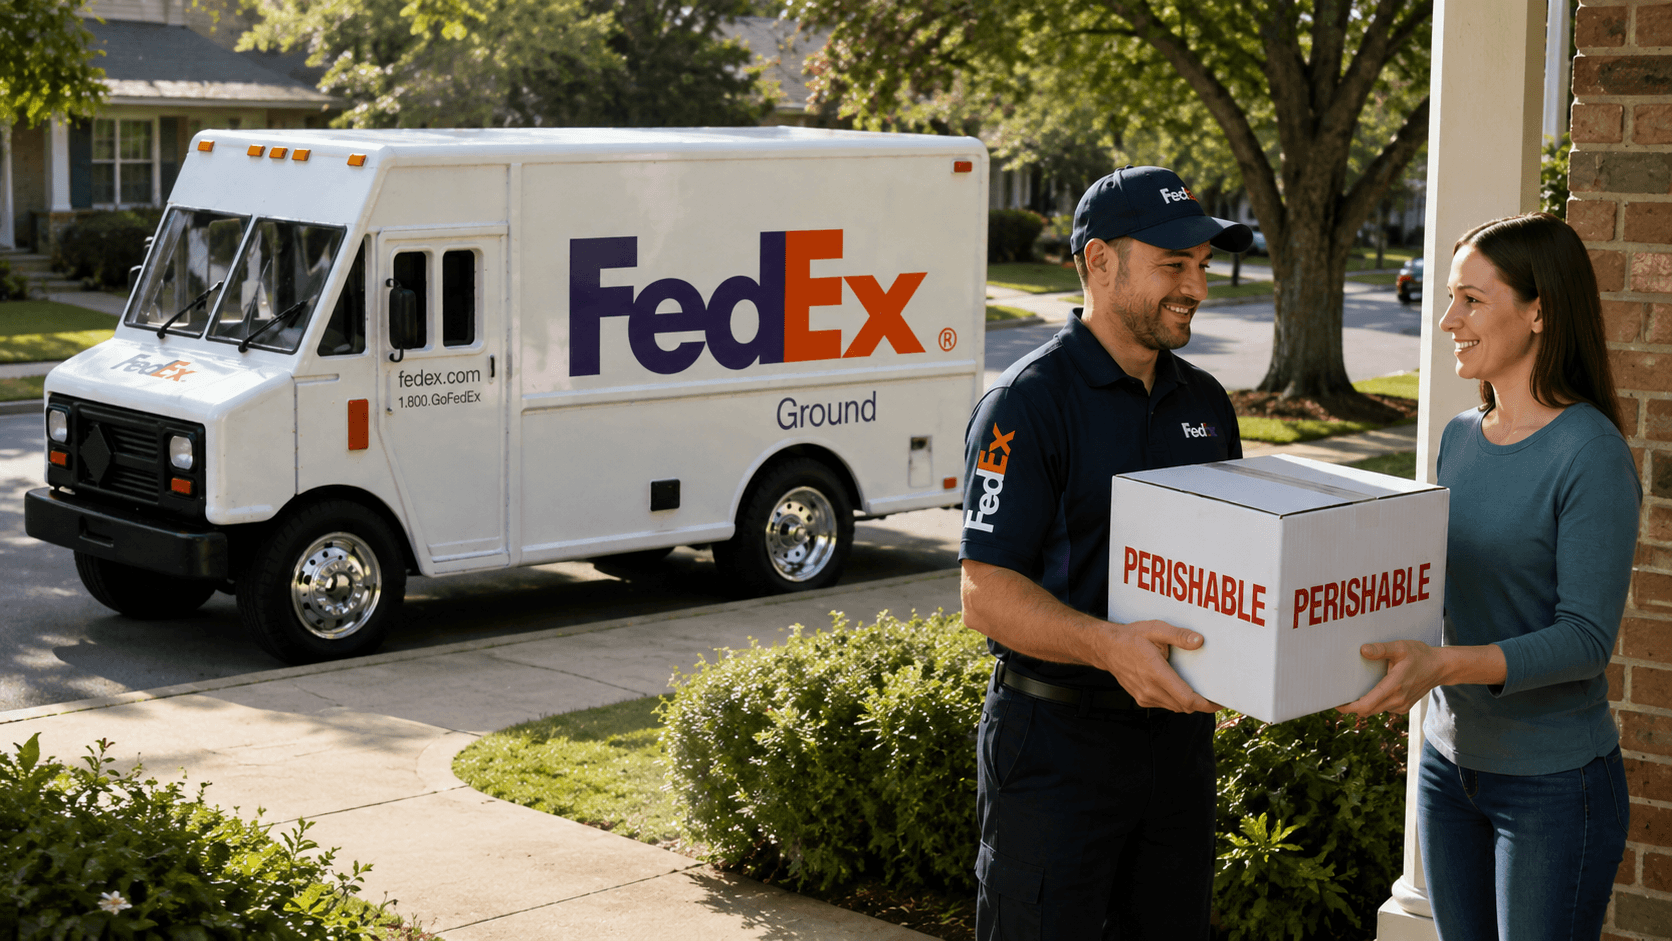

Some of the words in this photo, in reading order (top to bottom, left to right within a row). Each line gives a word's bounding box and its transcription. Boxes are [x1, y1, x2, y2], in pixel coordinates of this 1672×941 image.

[1159, 186, 1199, 204] Fed
[569, 229, 928, 377] FedEx
[110, 353, 198, 382] FedEx
[398, 369, 481, 388] fedex.com
[398, 390, 481, 408] 1.800.GoFedEx
[776, 391, 877, 430] Ground
[964, 422, 1016, 533] FedEx
[1123, 546, 1266, 627] PERISHABLE
[1293, 562, 1431, 629] PERISHABLE
